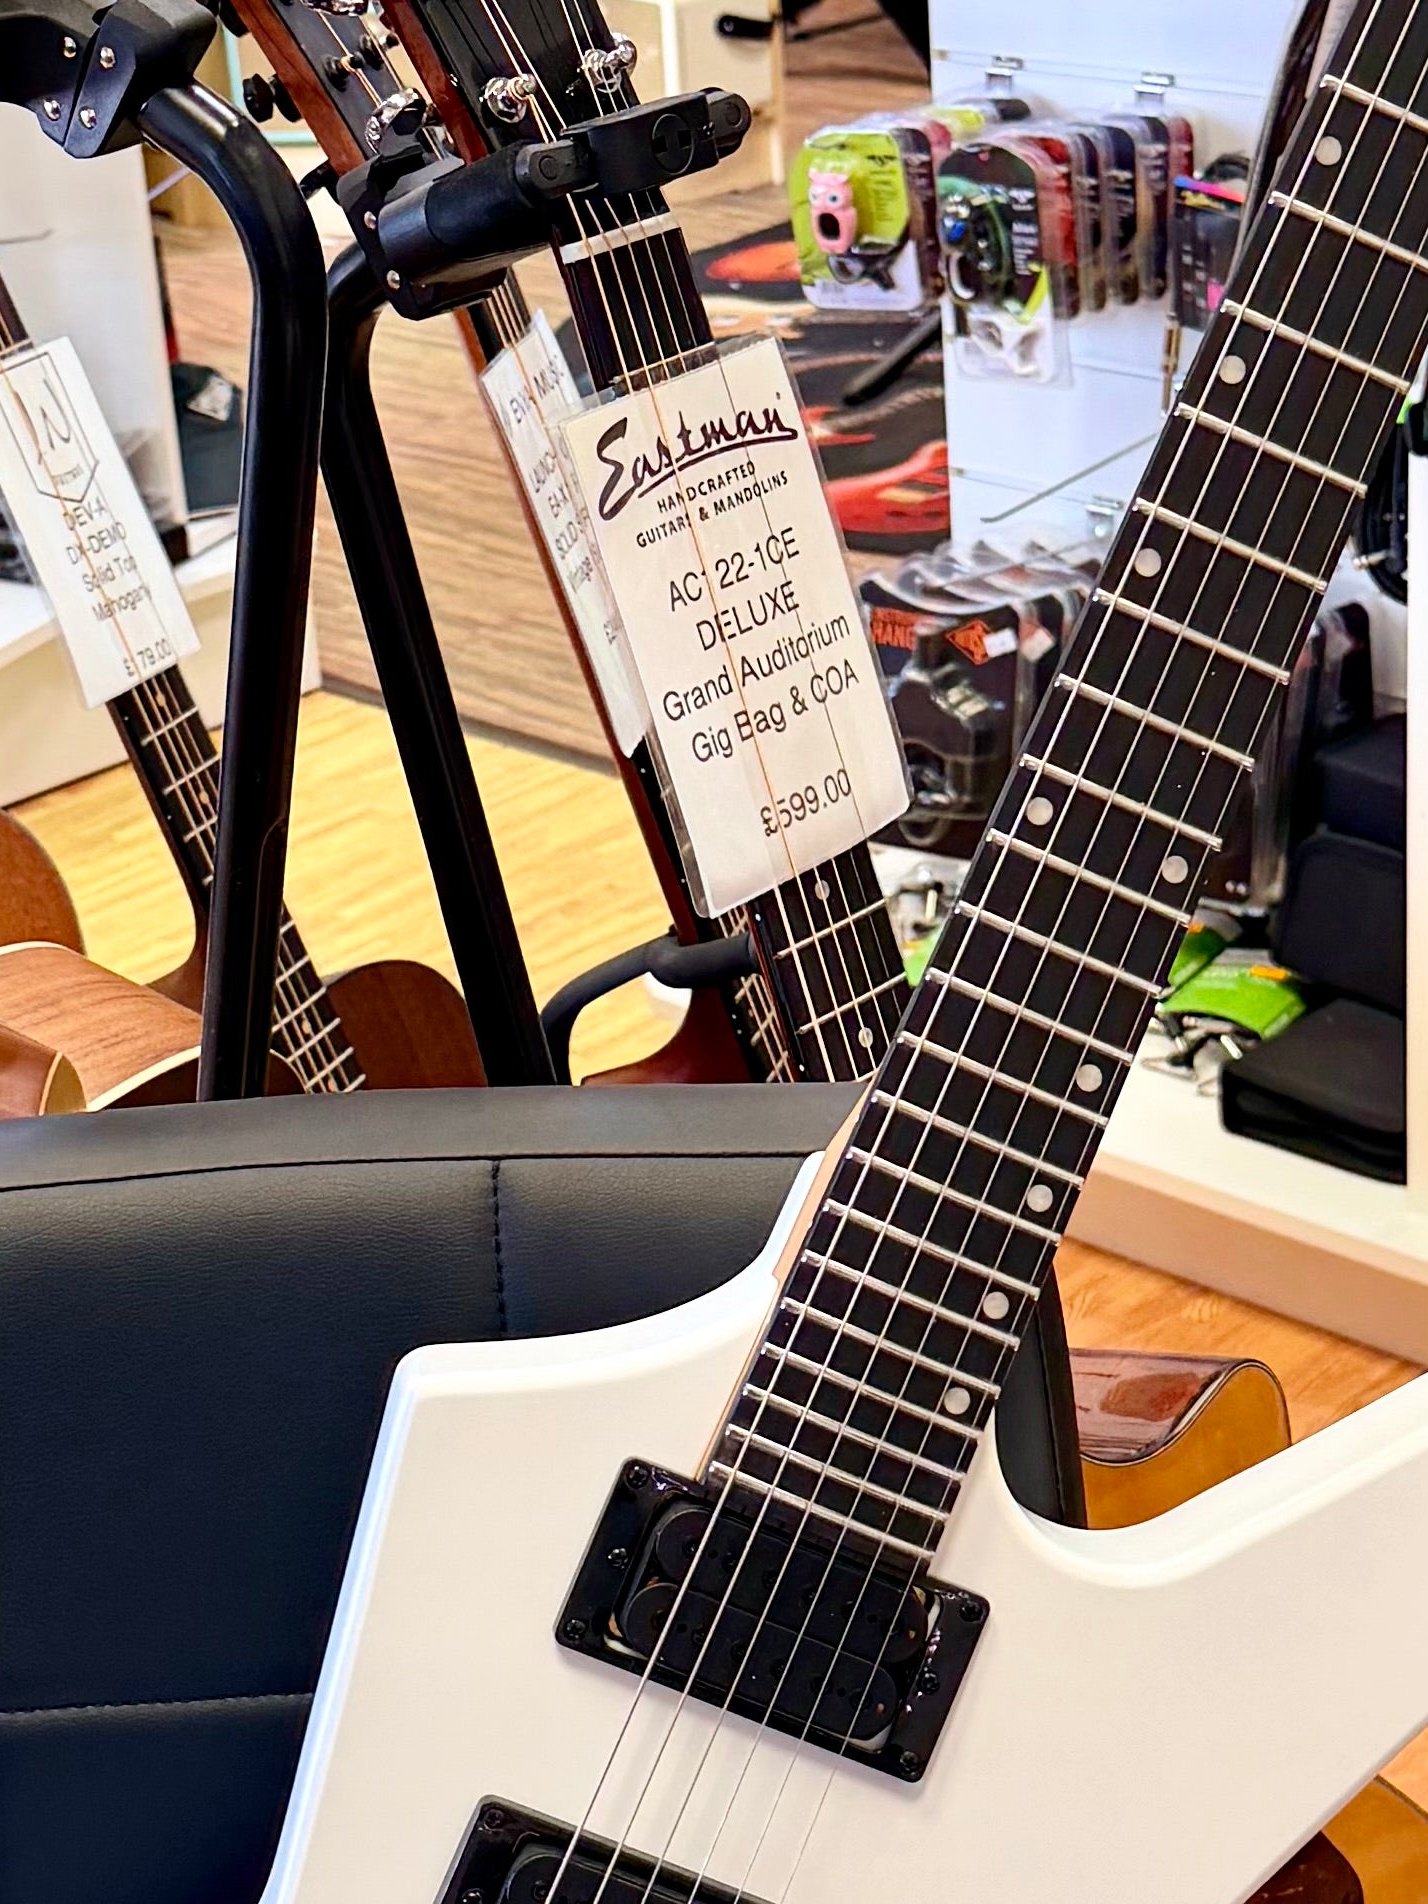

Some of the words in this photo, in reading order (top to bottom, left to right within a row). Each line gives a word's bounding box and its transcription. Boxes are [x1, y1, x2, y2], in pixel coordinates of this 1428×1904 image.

[596, 407, 799, 521] Eastman
[657, 460, 756, 515] HANDCRAFTED
[636, 514, 693, 548] GUITARS
[698, 506, 711, 522] &
[713, 470, 789, 517] MANDOLINS
[695, 580, 800, 651] DELUXE
[123, 638, 172, 678] £79.00
[662, 664, 734, 721] Grand
[740, 614, 851, 687] Auditorium
[691, 726, 734, 763] Gig
[733, 700, 788, 743] Bag
[789, 685, 809, 716] &
[810, 658, 860, 704] COA
[760, 768, 853, 837] £599.00
